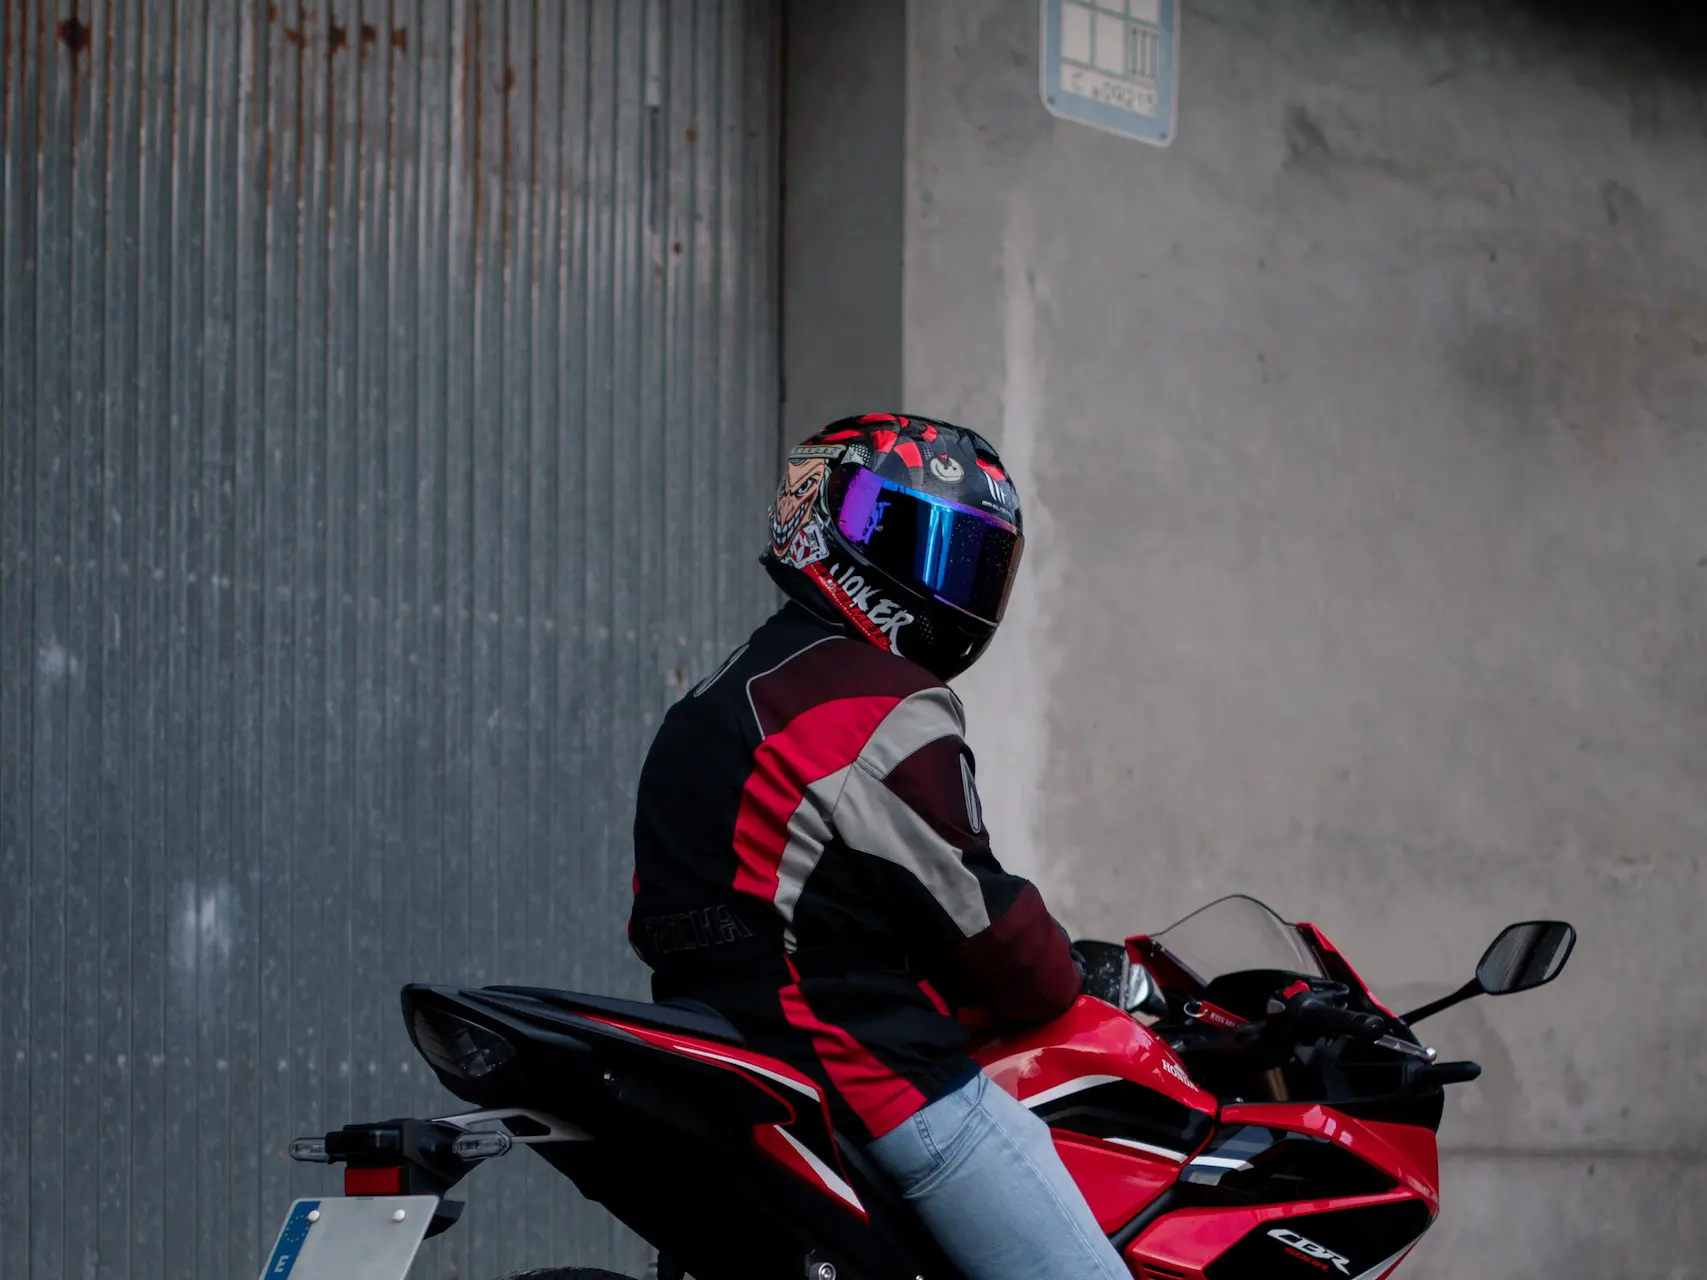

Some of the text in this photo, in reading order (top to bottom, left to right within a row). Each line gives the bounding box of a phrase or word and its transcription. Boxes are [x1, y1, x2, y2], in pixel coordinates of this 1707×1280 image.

[830, 563, 914, 659] JOKER
[1161, 1059, 1199, 1092] HONDA
[274, 1255, 289, 1273] E
[1267, 1228, 1350, 1276] CBR
